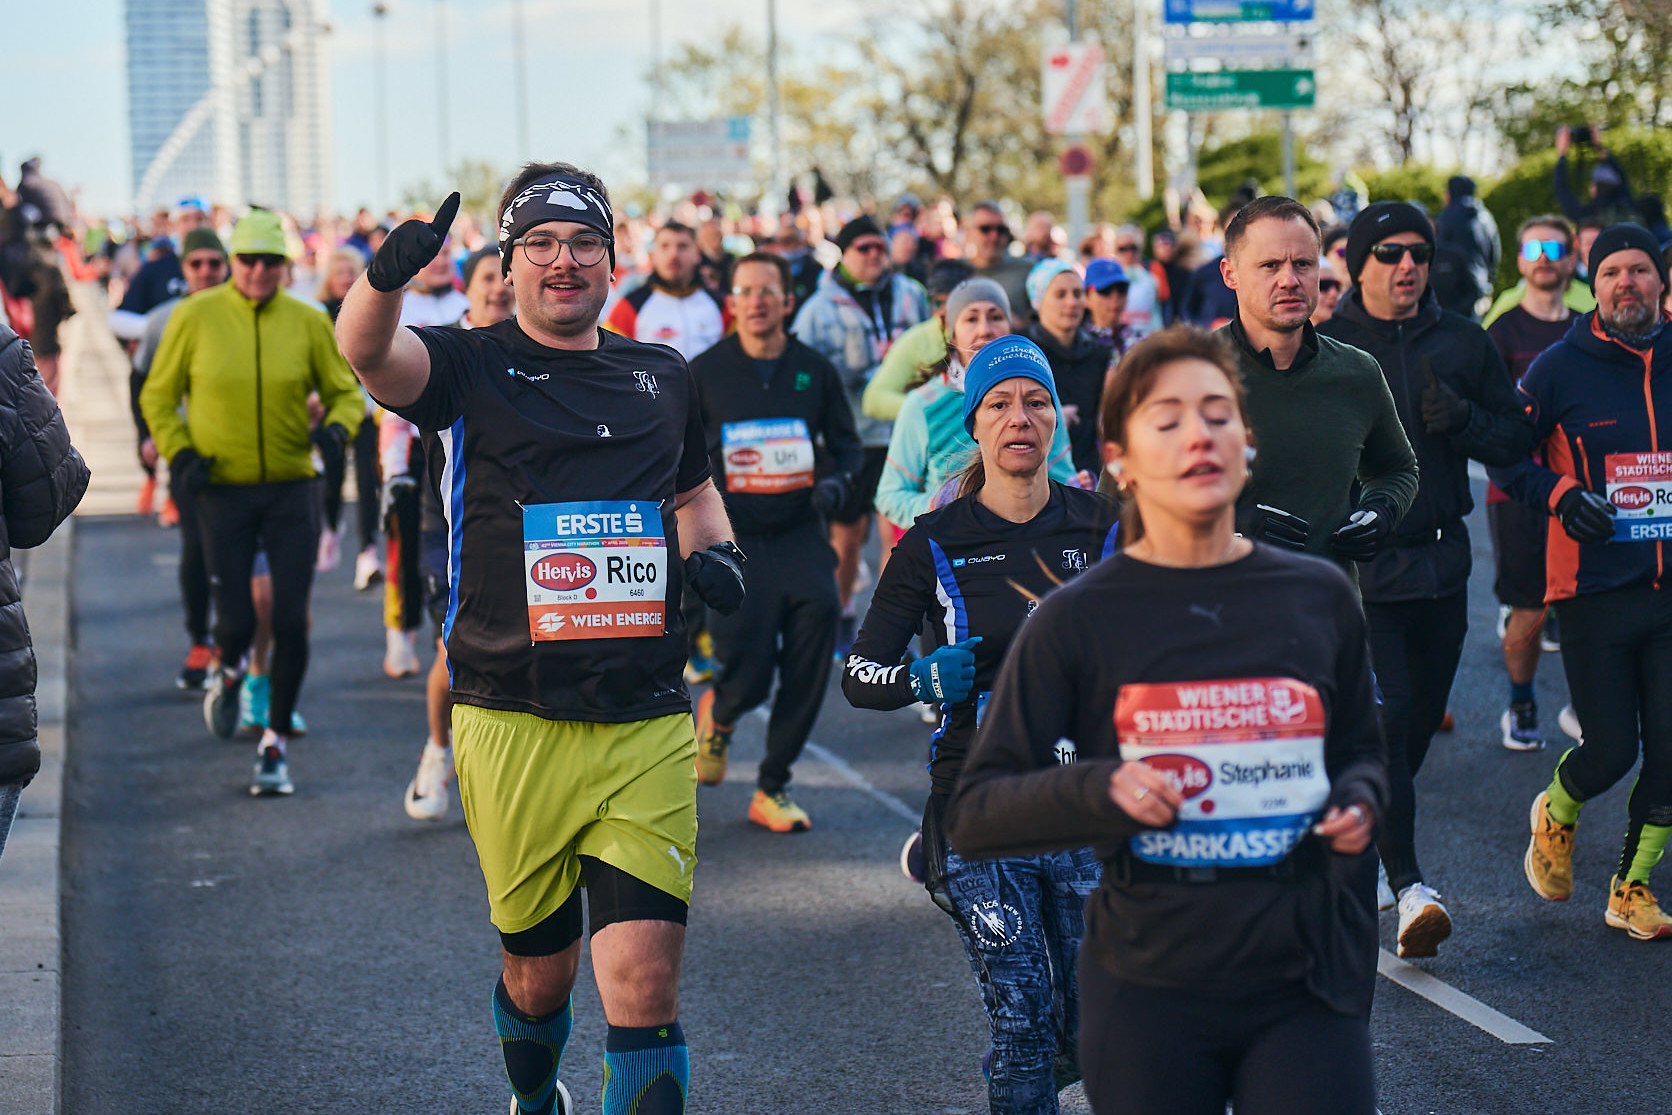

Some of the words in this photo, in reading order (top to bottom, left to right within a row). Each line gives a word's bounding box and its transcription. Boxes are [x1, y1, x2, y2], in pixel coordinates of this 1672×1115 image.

[1636, 454, 1672, 465] WIENE
[1614, 490, 1650, 505] Hervis
[1656, 488, 1672, 505] Ro
[556, 513, 623, 536] ERSTE
[537, 562, 592, 583] Hervis
[606, 555, 657, 584] Rico
[571, 614, 613, 628] WIEN
[616, 612, 662, 626] ENERGIE
[1176, 683, 1267, 708] WIENER
[1053, 747, 1077, 765] Chr
[1219, 758, 1314, 788] Stephanie
[971, 916, 998, 948] MARATHON
[1000, 935, 1017, 947] CITY
